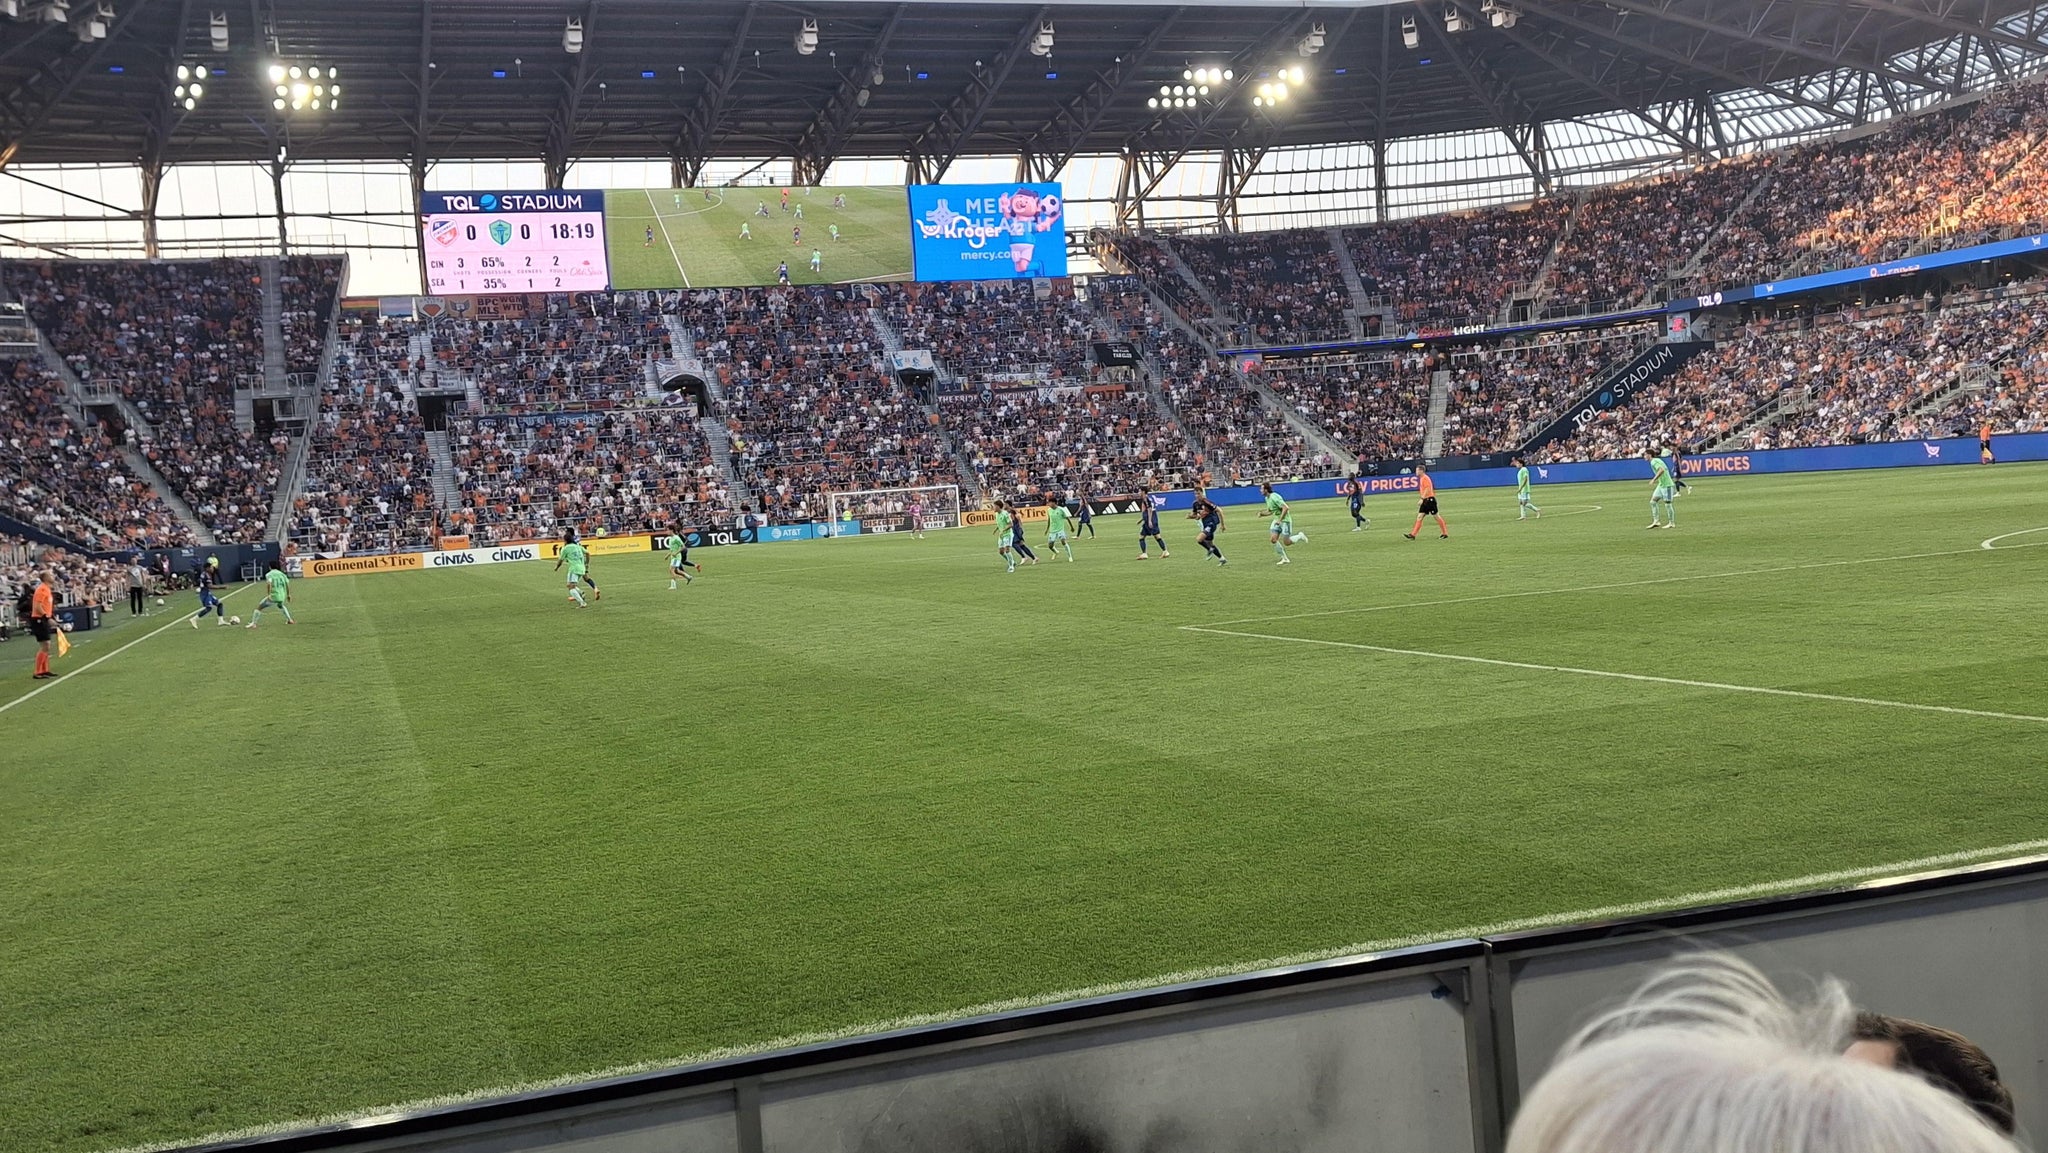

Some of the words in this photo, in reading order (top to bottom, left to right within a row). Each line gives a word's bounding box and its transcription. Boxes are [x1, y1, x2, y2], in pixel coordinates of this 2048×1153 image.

[443, 195, 480, 211] TQL
[501, 194, 582, 210] STADIUM
[466, 224, 476, 241] 0
[520, 224, 530, 240] 0
[549, 223, 595, 239] 18:19
[944, 215, 1001, 249] Kroger
[431, 260, 444, 268] CIN
[457, 258, 464, 268] 3
[481, 257, 505, 268] 65%
[525, 256, 532, 267] 2
[553, 256, 559, 266] 2
[431, 279, 445, 287] SEA
[459, 280, 465, 289] 1
[484, 278, 506, 289] 35%
[528, 278, 533, 288] 1
[555, 277, 561, 287] 2
[478, 298, 499, 306] BPC
[1697, 295, 1715, 308] TQL
[478, 306, 499, 315] MLS
[1453, 324, 1486, 335] LIGHT
[1571, 403, 1602, 428] TQL
[1613, 346, 1674, 398] STADIUM
[1681, 459, 1702, 474] OW
[1705, 455, 1750, 472] PRICES
[1371, 476, 1418, 491] PRICES
[922, 514, 955, 524] SCOUNT
[1025, 508, 1047, 519] Tire
[708, 532, 738, 546] TQL
[782, 528, 802, 536] AT&T
[434, 551, 475, 566] CINTAS
[492, 547, 532, 562] CINTAS
[313, 558, 378, 575] Continental
[385, 555, 415, 568] Tire
